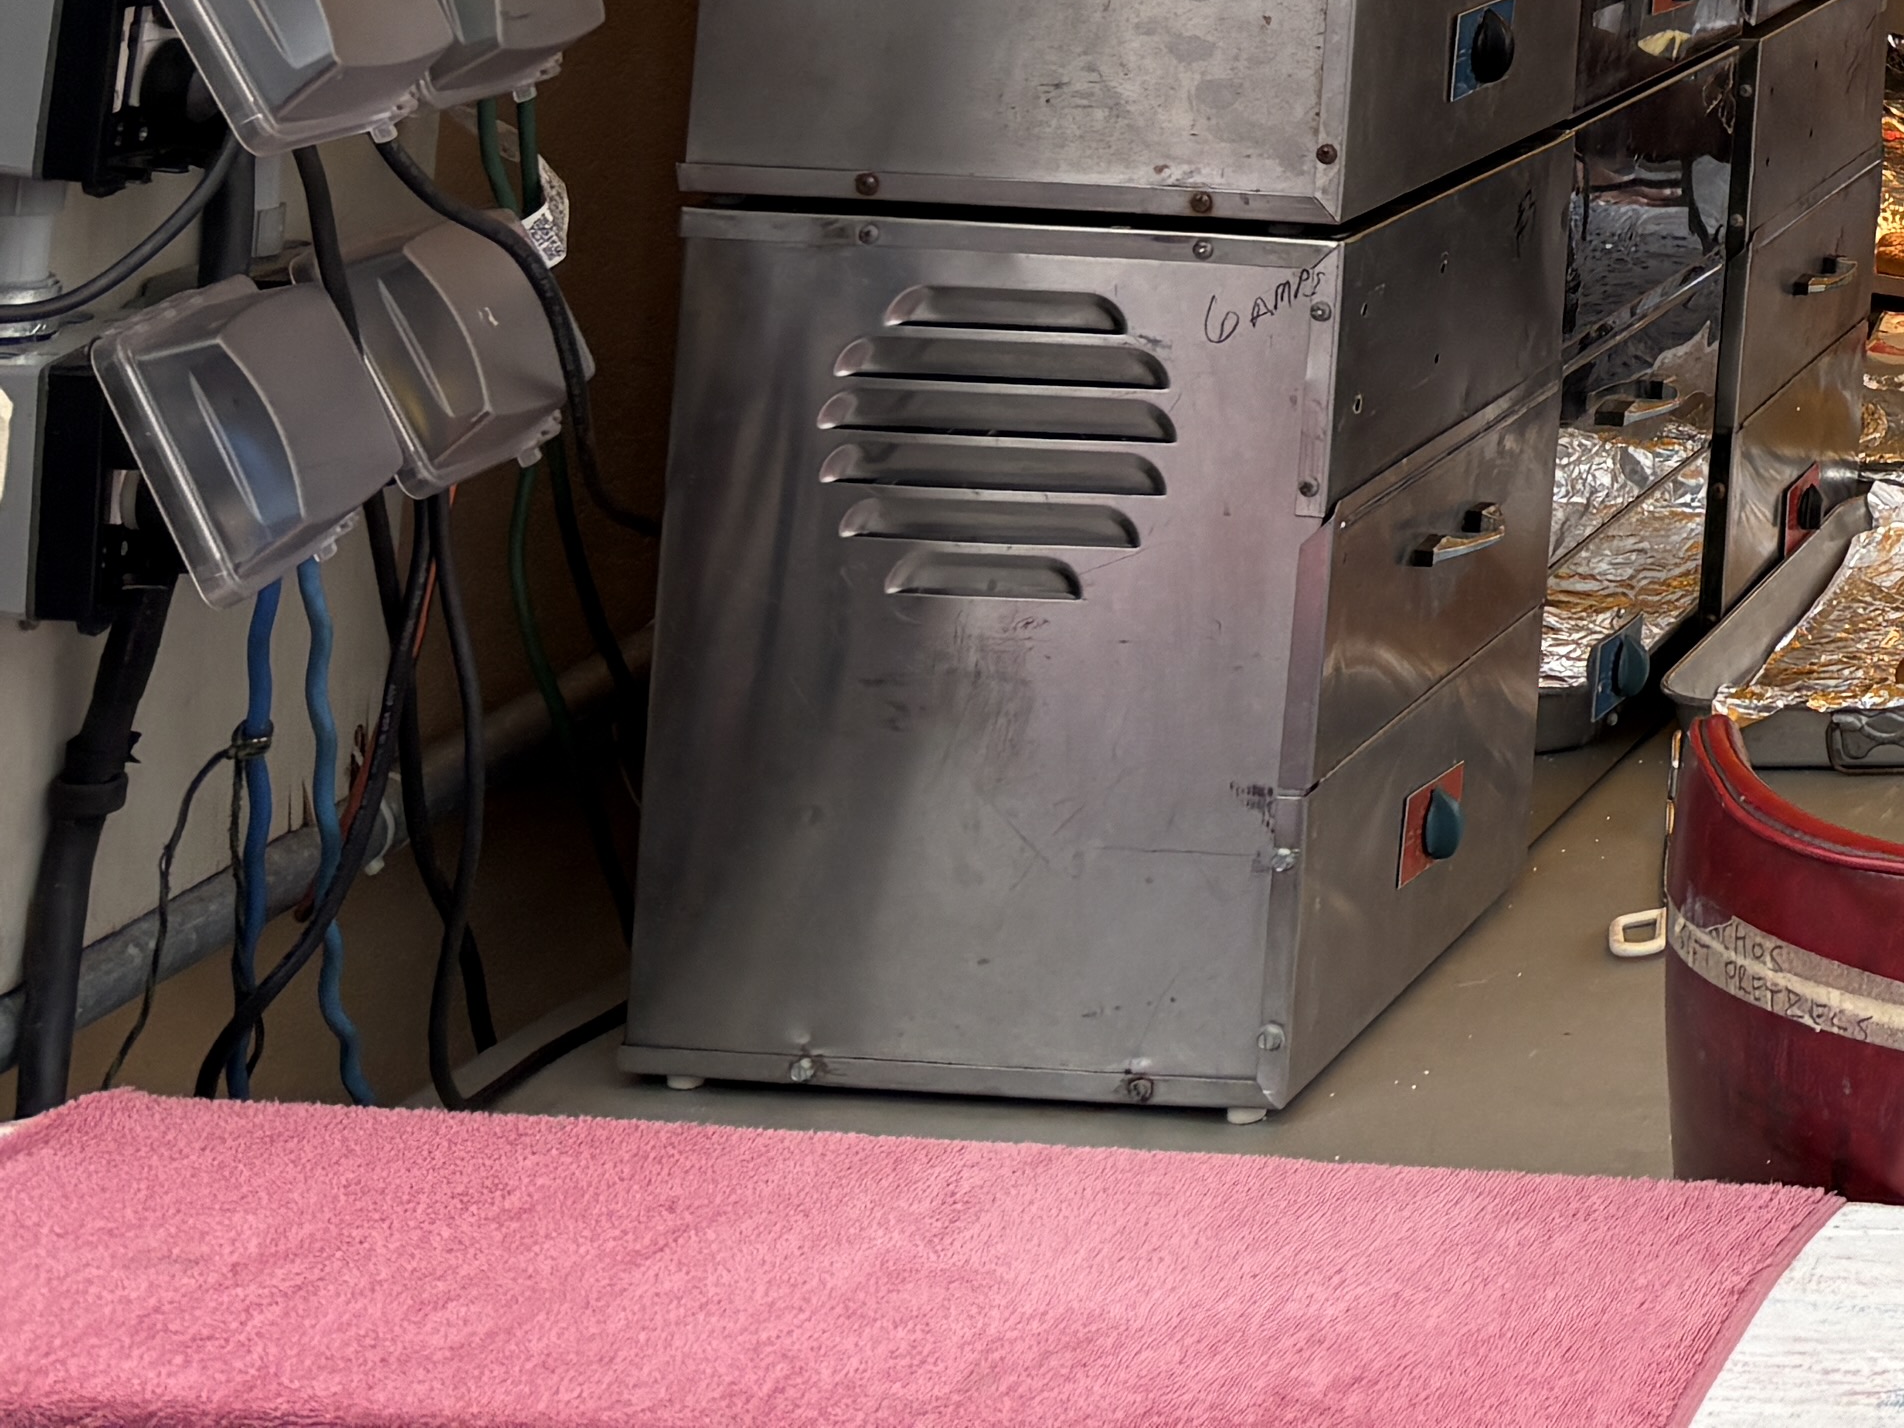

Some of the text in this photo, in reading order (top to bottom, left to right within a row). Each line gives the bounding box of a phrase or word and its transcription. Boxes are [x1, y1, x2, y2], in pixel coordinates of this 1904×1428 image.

[1204, 268, 1325, 343] 6 AMPS
[1724, 959, 1873, 1040] PRETZELS
